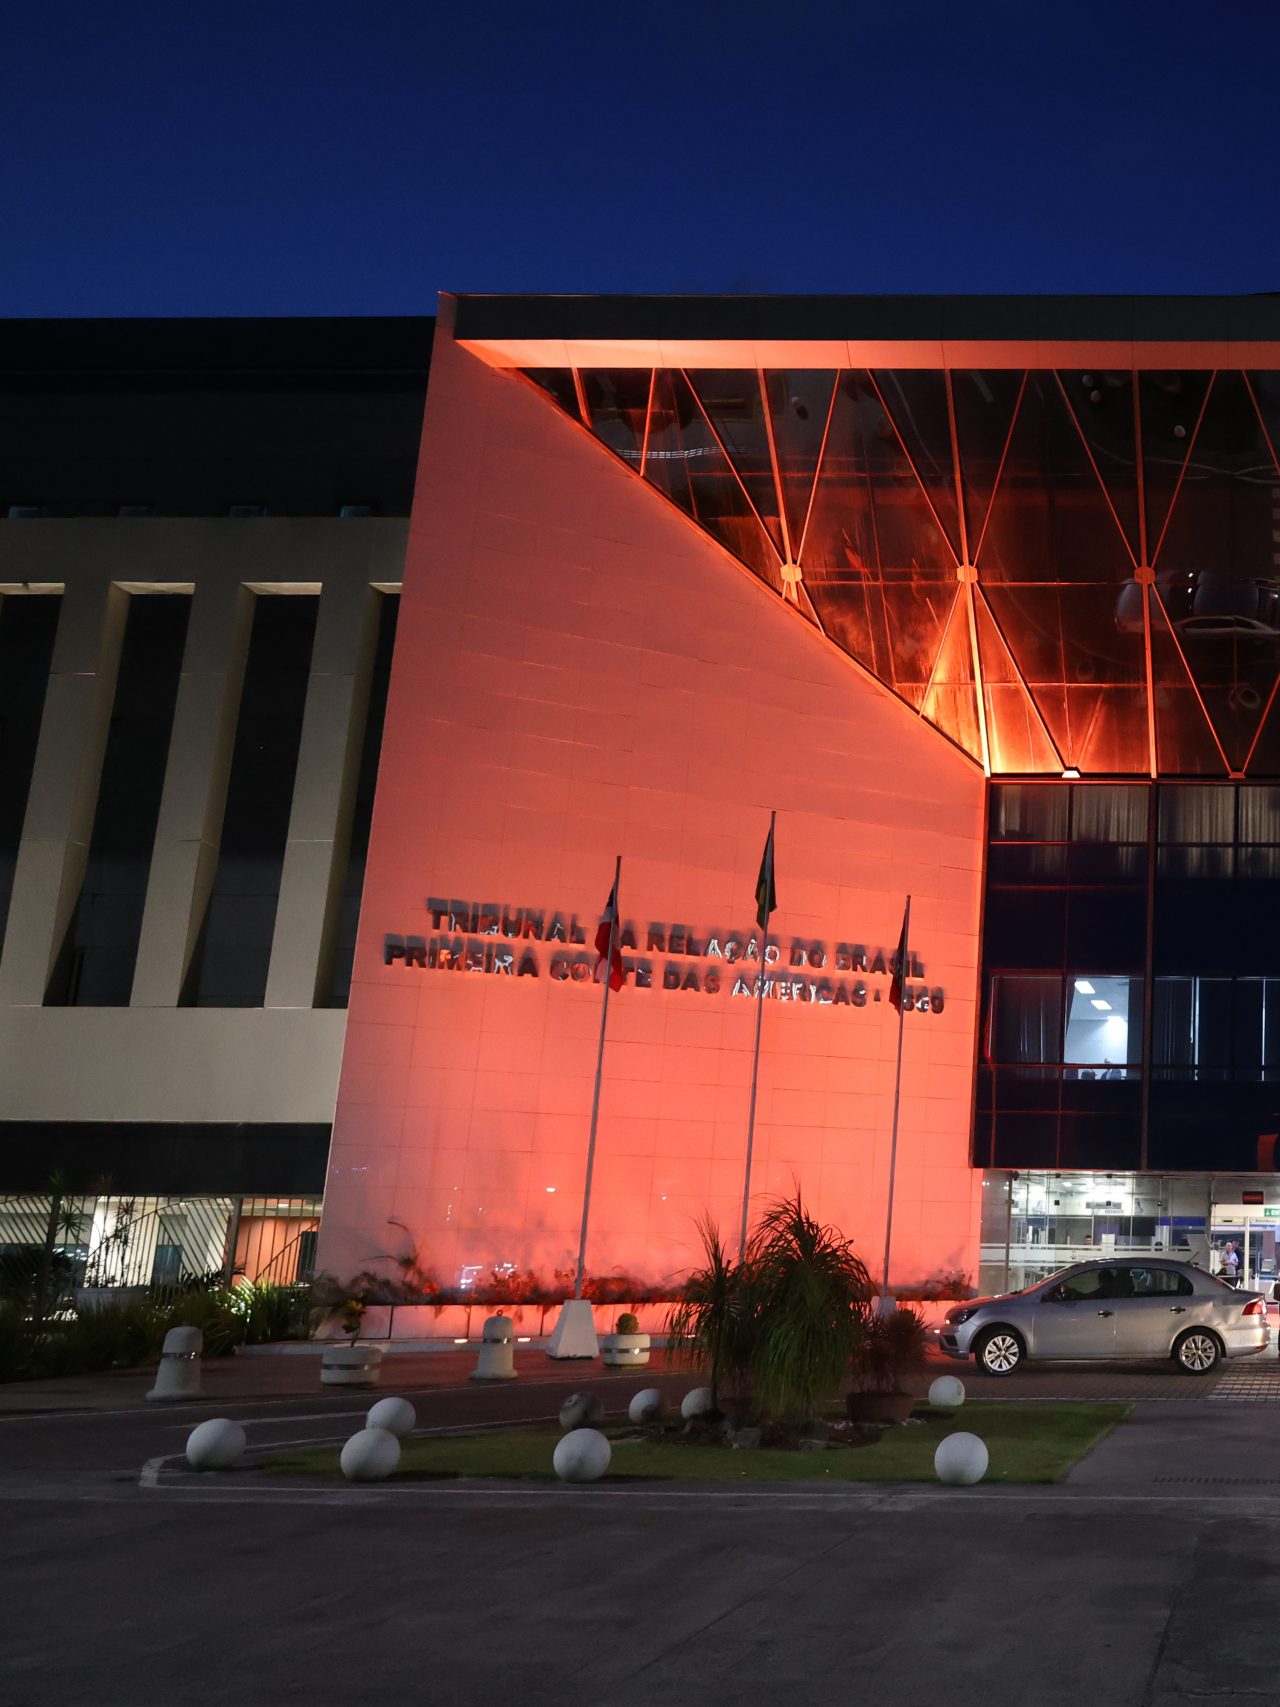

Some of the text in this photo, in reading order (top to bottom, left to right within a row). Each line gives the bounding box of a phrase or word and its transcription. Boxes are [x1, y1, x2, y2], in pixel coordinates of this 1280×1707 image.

[384, 936, 538, 977] PRIMEIRA
[550, 952, 652, 987] COTE
[663, 963, 720, 993] DAS
[428, 900, 586, 944] TRIBUNAL
[789, 940, 827, 968] DO
